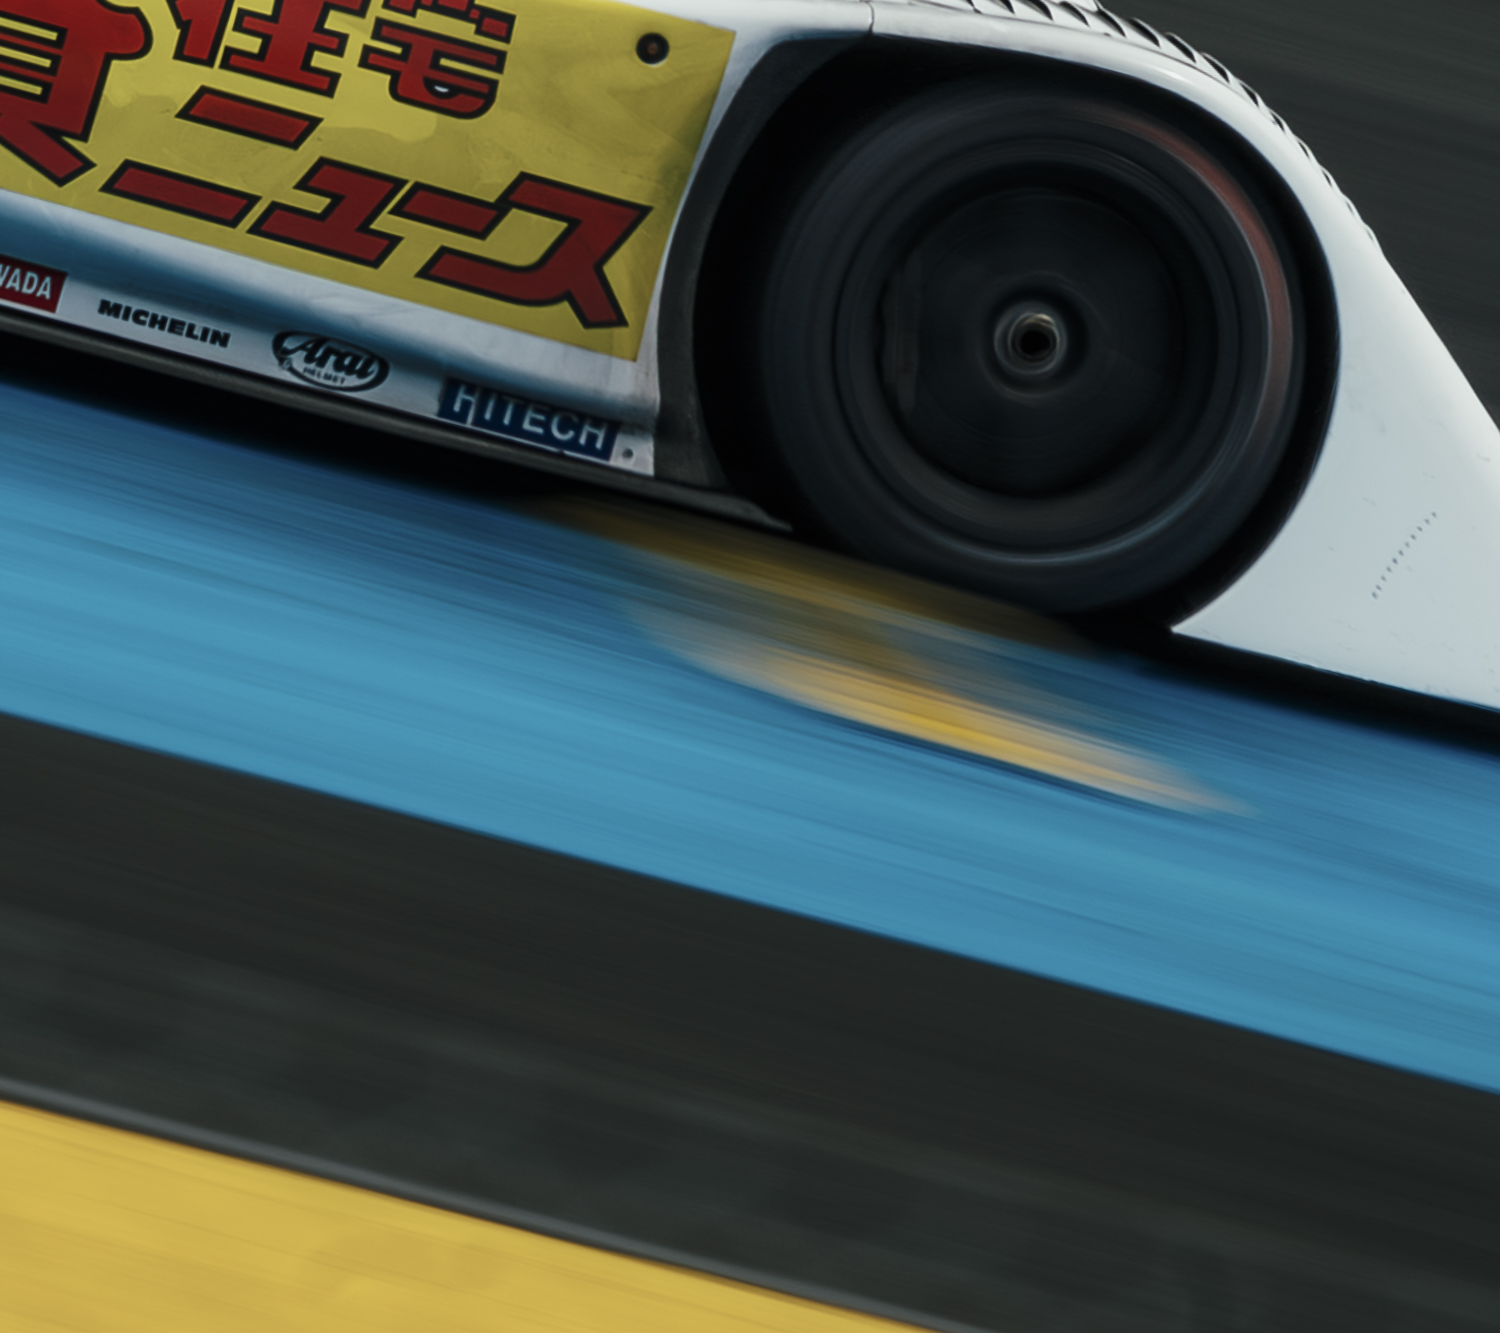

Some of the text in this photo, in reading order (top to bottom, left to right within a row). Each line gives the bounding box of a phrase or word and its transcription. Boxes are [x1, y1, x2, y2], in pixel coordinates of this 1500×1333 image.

[98, 299, 230, 348] MICHELIN
[282, 332, 374, 380] Arai
[453, 383, 607, 450] HITECH
